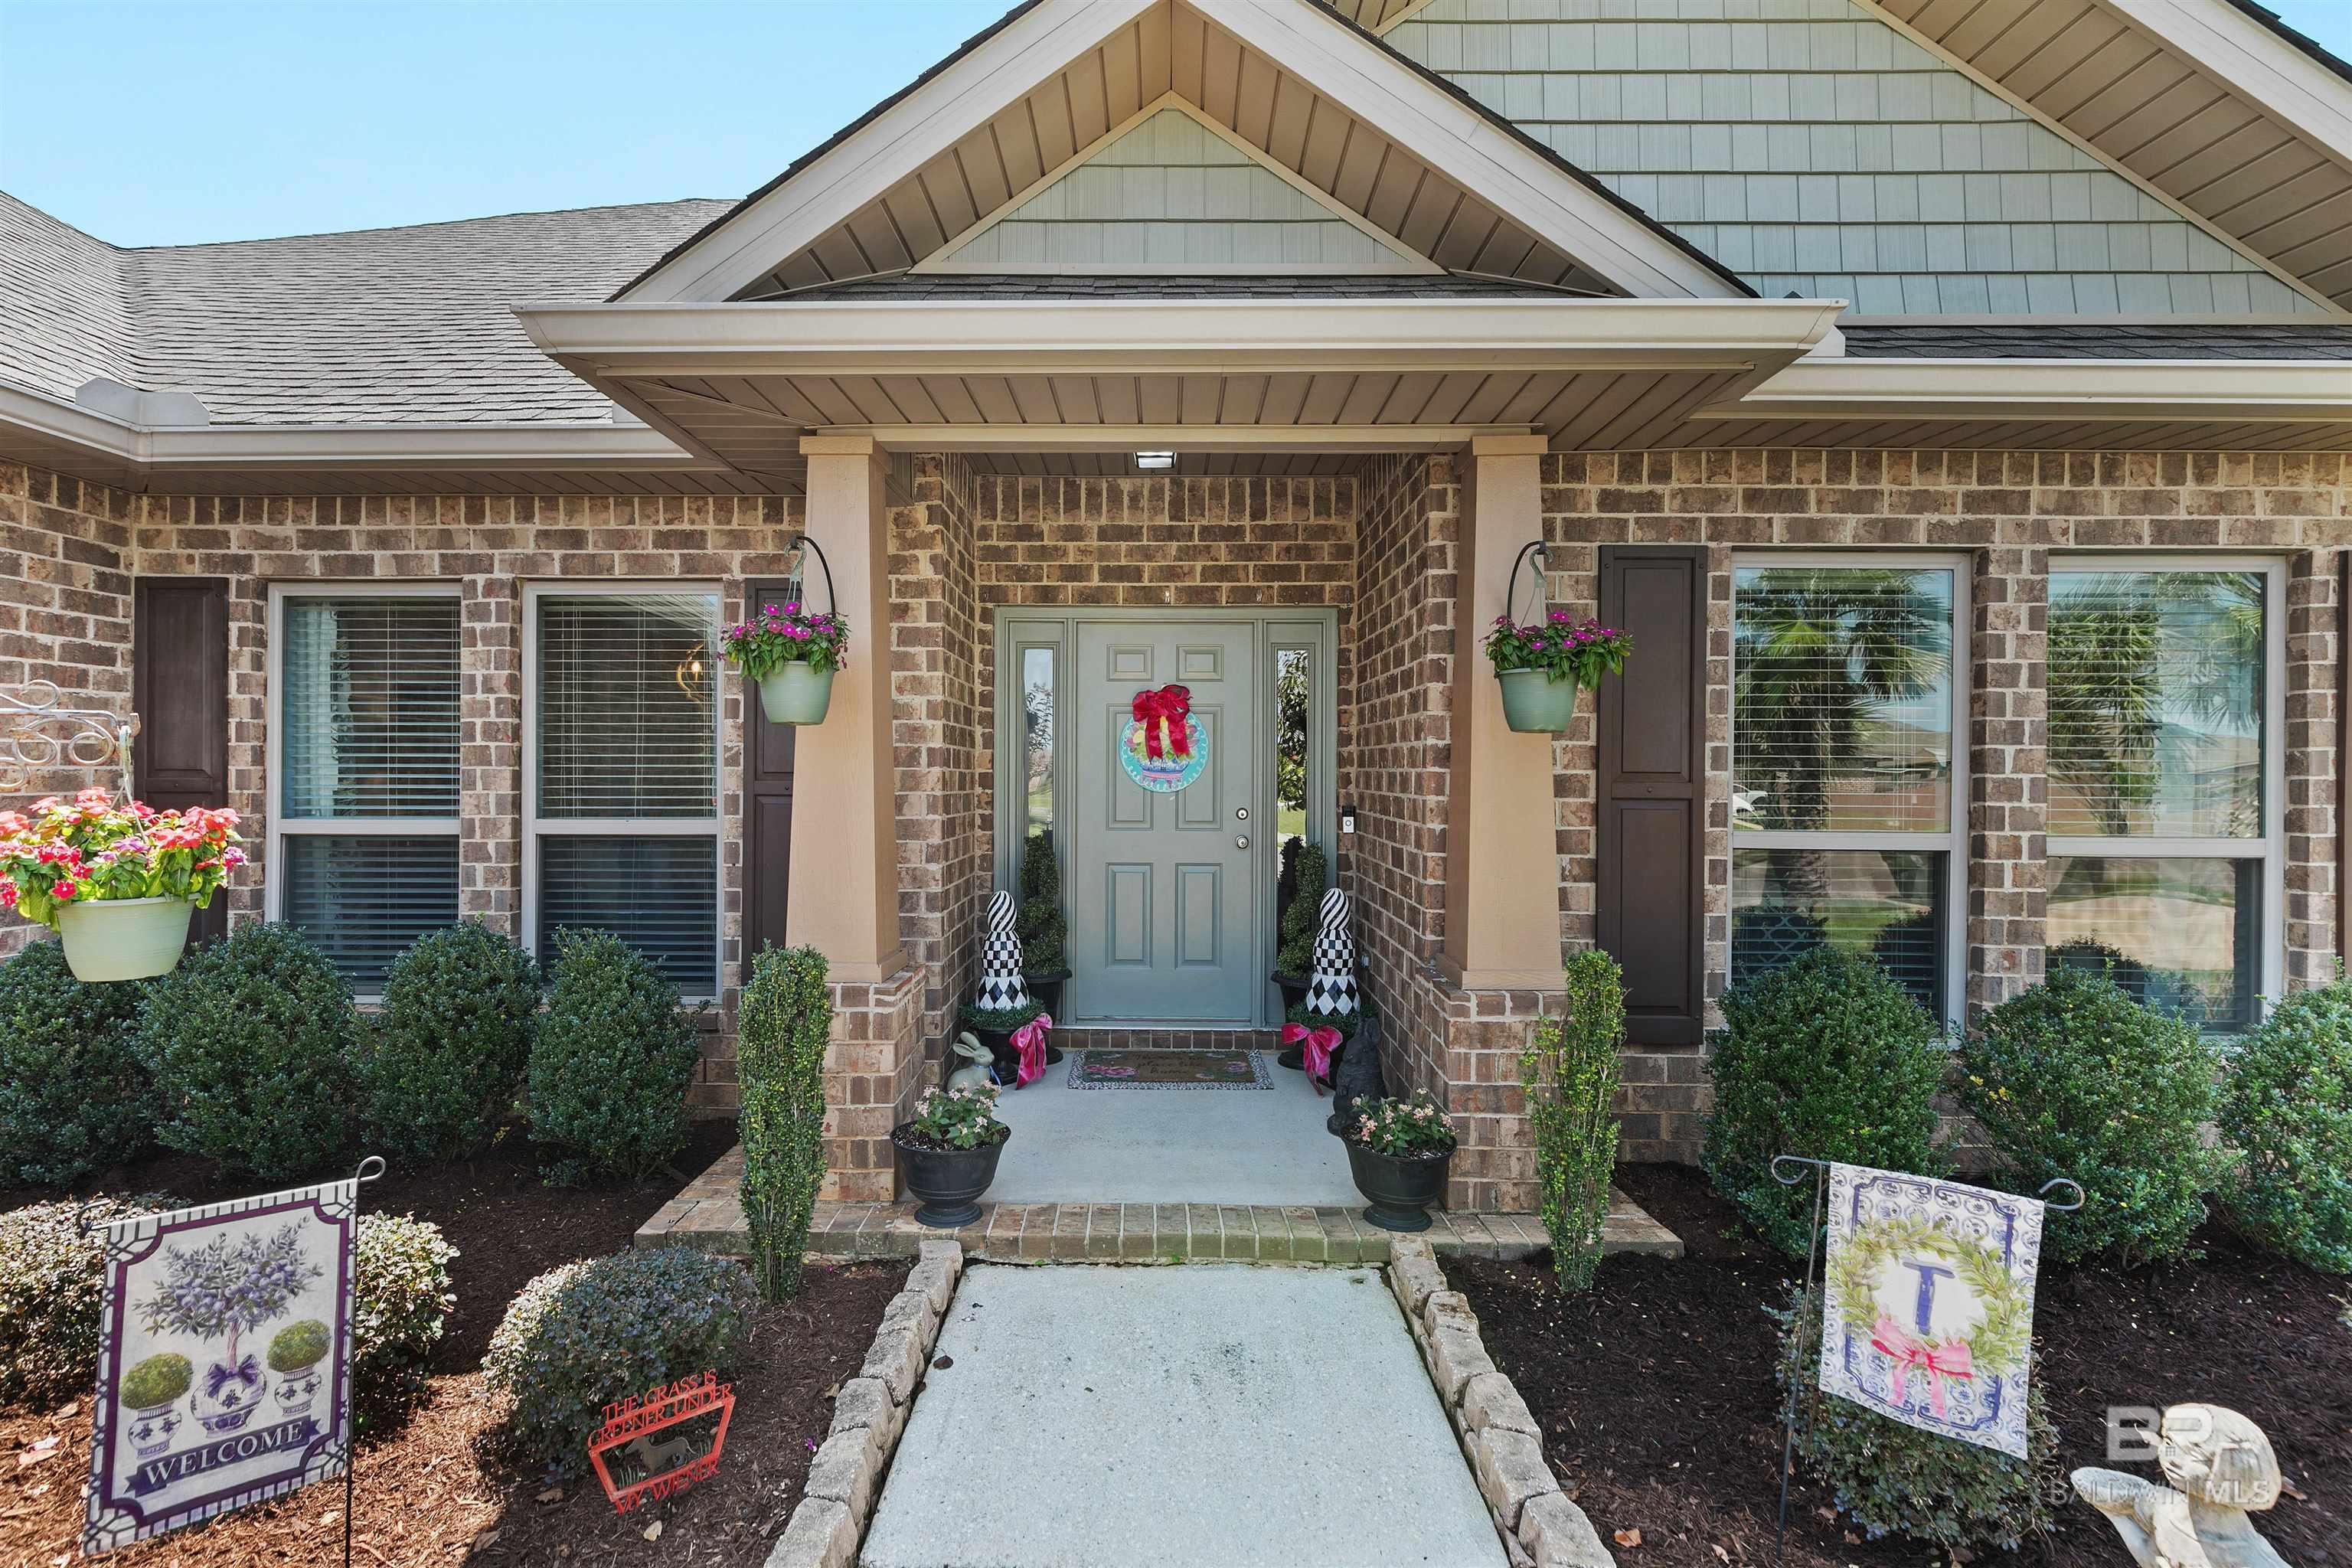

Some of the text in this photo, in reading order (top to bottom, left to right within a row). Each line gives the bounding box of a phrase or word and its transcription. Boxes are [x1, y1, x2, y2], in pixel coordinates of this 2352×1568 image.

[1903, 1261, 1955, 1336] T
[602, 1368, 717, 1422] THE GRASS IS
[674, 1383, 733, 1417] UNDER
[145, 1420, 302, 1485] WELCOME
[652, 1459, 720, 1501] WIENER
